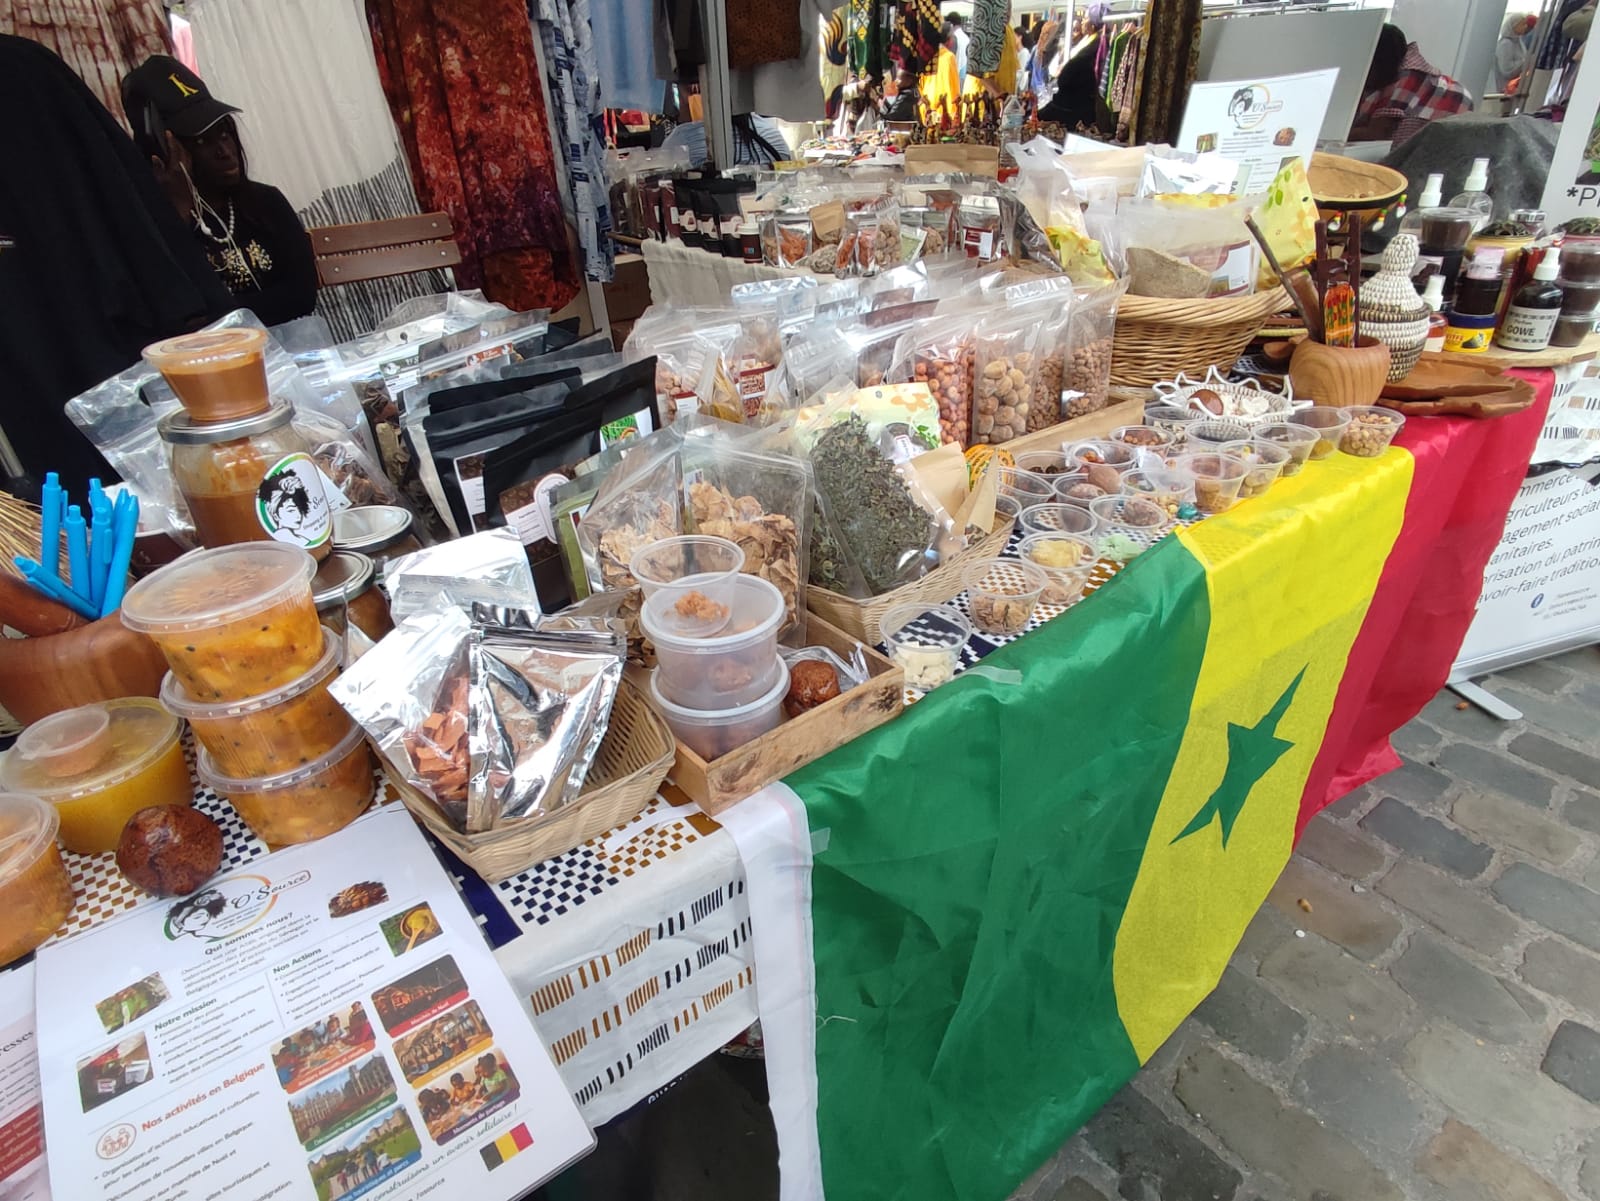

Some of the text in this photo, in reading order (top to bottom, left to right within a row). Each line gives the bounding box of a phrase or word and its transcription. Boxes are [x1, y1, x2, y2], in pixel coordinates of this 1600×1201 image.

[1544, 551, 1561, 567] du
[1550, 557, 1600, 581] traditio
[205, 944, 222, 955] Qui
[225, 926, 264, 947] sommes
[273, 963, 290, 974] Nos
[291, 948, 322, 966] Actions
[154, 998, 217, 1031] Notre mission
[141, 1063, 265, 1132] Nos activités en Belgique
